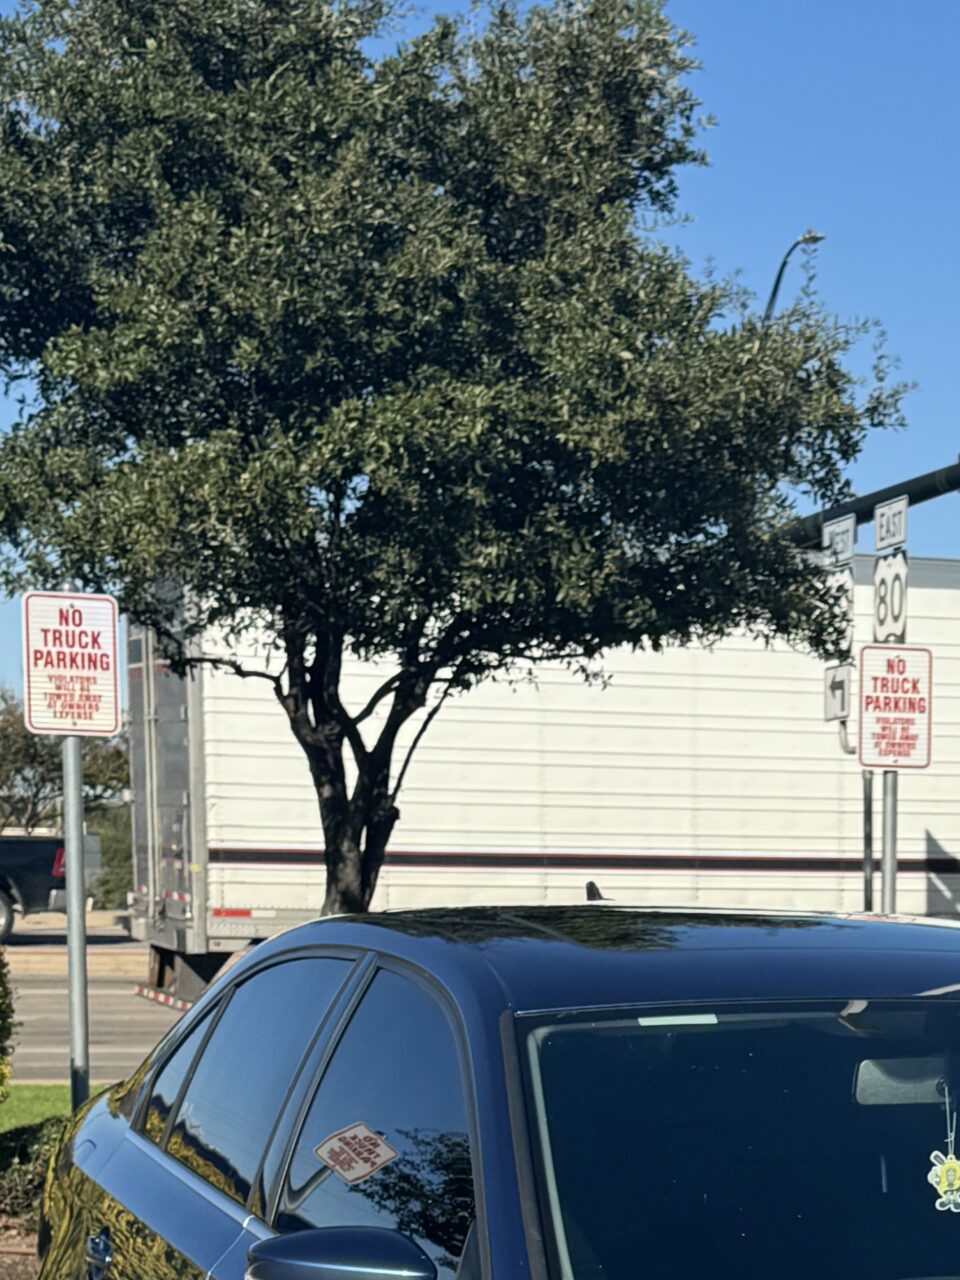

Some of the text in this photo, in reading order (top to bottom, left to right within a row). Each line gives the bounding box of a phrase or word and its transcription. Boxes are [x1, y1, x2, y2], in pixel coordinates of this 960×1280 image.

[879, 510, 903, 543] EAST
[877, 572, 903, 627] 80
[58, 608, 83, 627] NO
[41, 628, 102, 650] TRUCK
[33, 650, 110, 672] PARKING
[886, 658, 906, 675] NO
[47, 674, 98, 685] VIOLATORS
[55, 682, 91, 692] WILL BE
[872, 676, 920, 694] TRUCK
[44, 692, 103, 703] TOWED AWAY
[47, 701, 57, 709] AT
[865, 695, 926, 714] PARKING
[53, 710, 93, 720] EXPENSE
